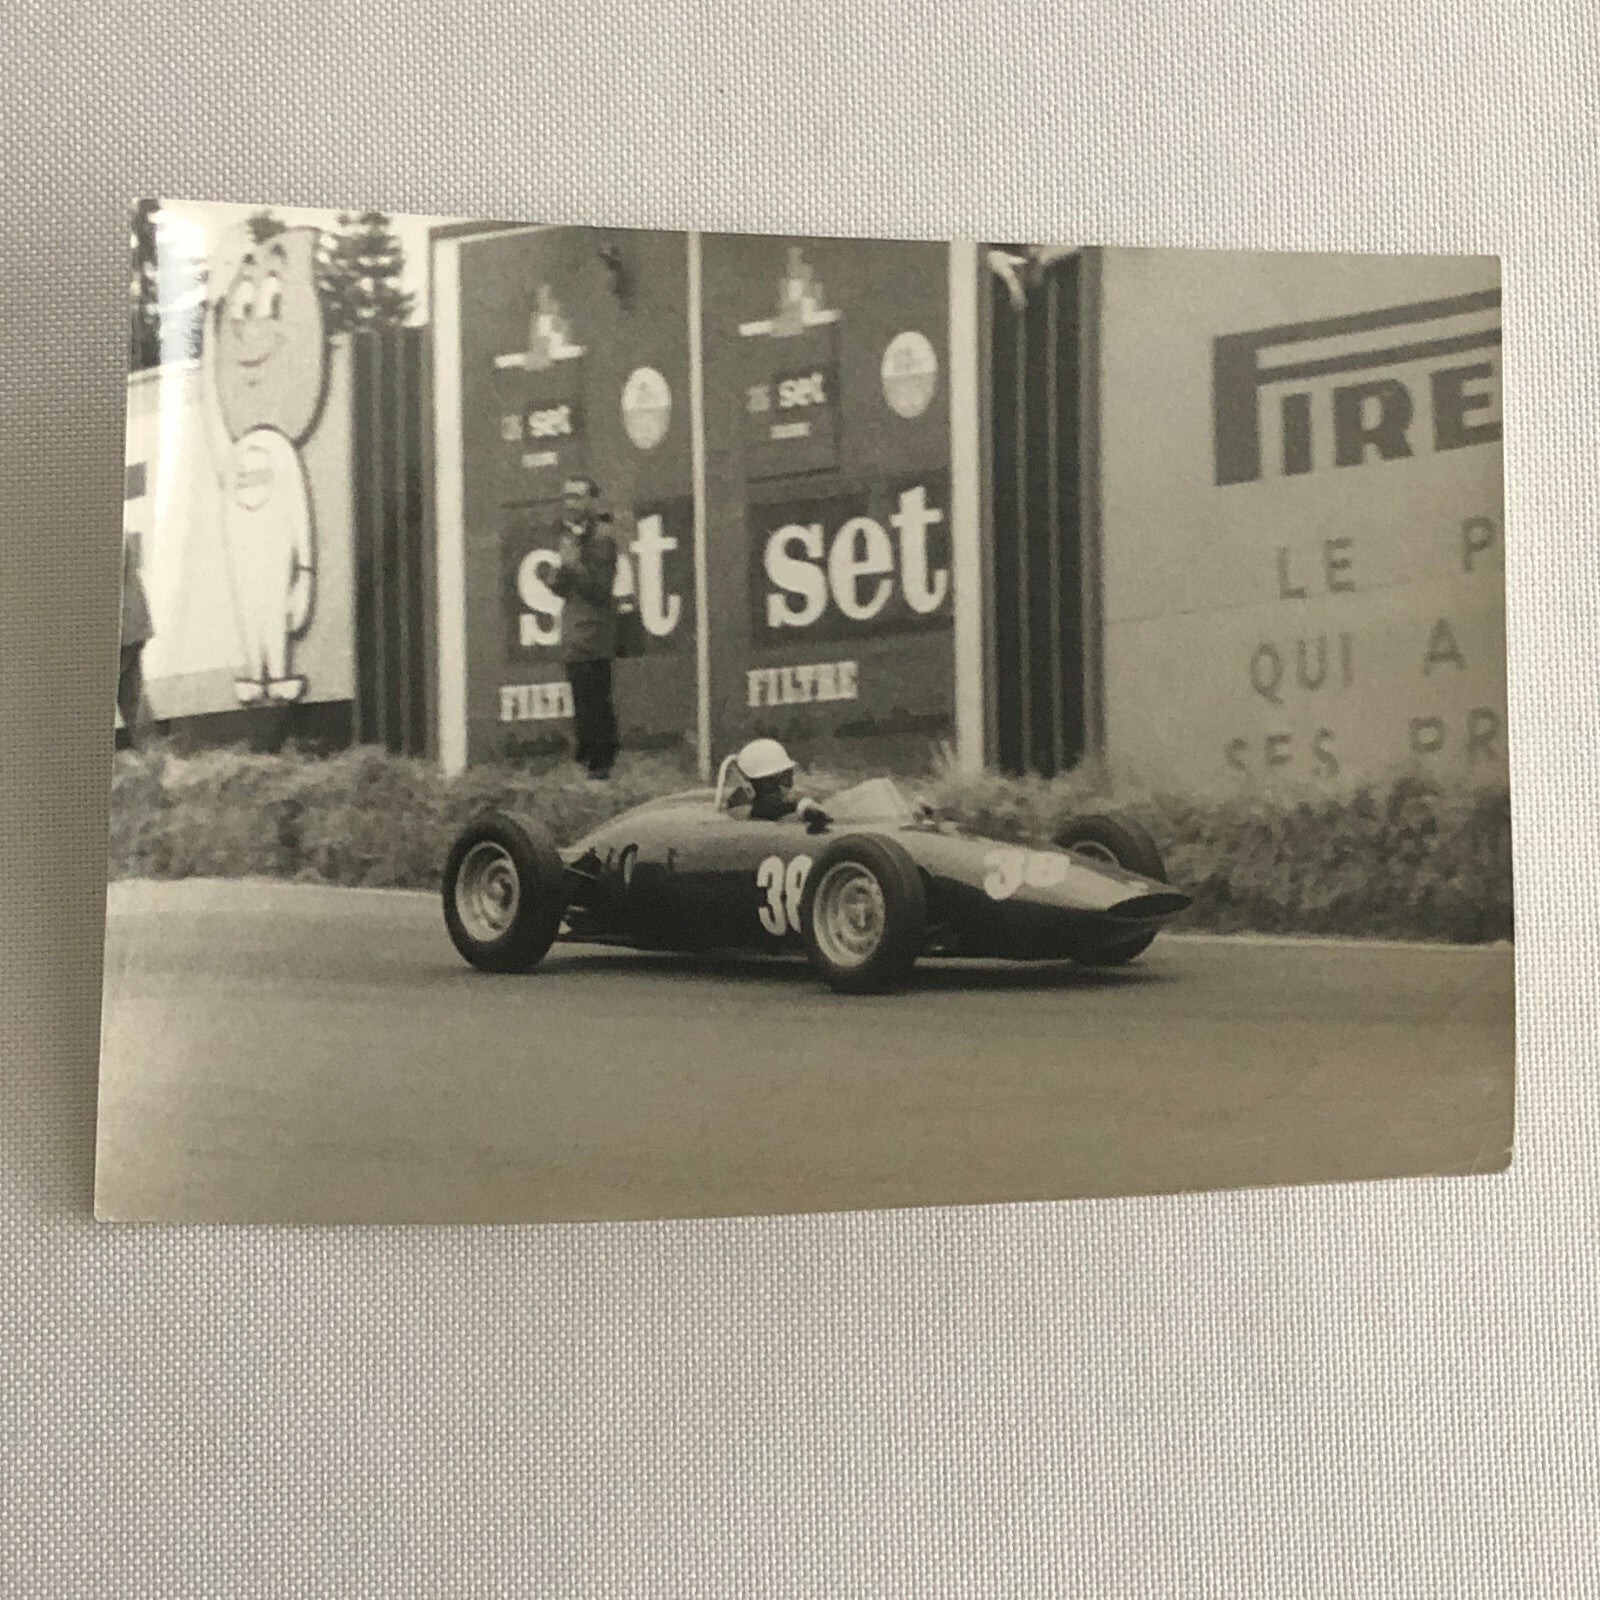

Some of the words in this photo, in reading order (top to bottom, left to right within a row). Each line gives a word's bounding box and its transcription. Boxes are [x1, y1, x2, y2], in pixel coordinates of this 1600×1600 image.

[764, 486, 949, 628] set
[1275, 537, 1354, 600] LE
[747, 661, 858, 707] FILTRE
[1250, 631, 1353, 704] QUI
[1422, 617, 1465, 676] A
